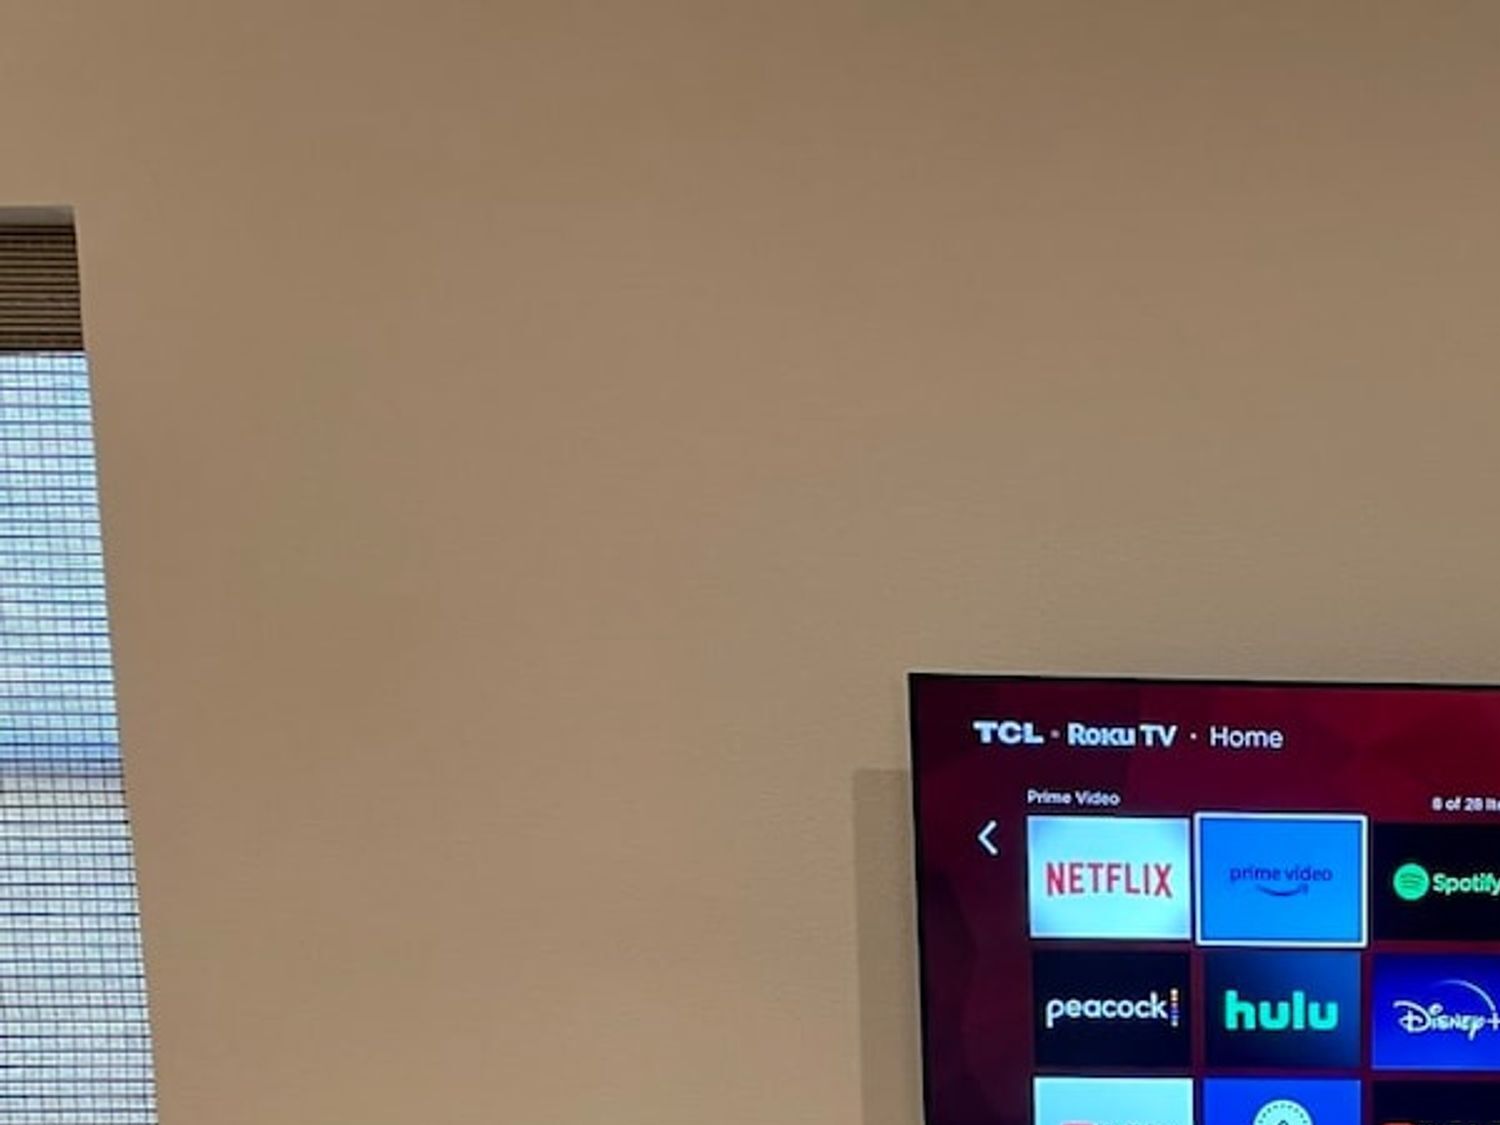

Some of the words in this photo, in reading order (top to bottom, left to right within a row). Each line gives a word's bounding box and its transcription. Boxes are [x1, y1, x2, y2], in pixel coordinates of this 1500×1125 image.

[973, 720, 1044, 744] TCL
[1067, 722, 1136, 746] Roku
[1139, 725, 1177, 746] TV
[1210, 726, 1284, 748] Home
[1027, 790, 1071, 804] Prime
[1075, 791, 1121, 806] Video
[1445, 796, 1462, 811] of
[1046, 863, 1173, 898] NETFLIX
[1230, 866, 1281, 883] prime
[1285, 866, 1333, 882] video
[1046, 991, 1168, 1029] peacock
[1225, 989, 1339, 1031] hulu
